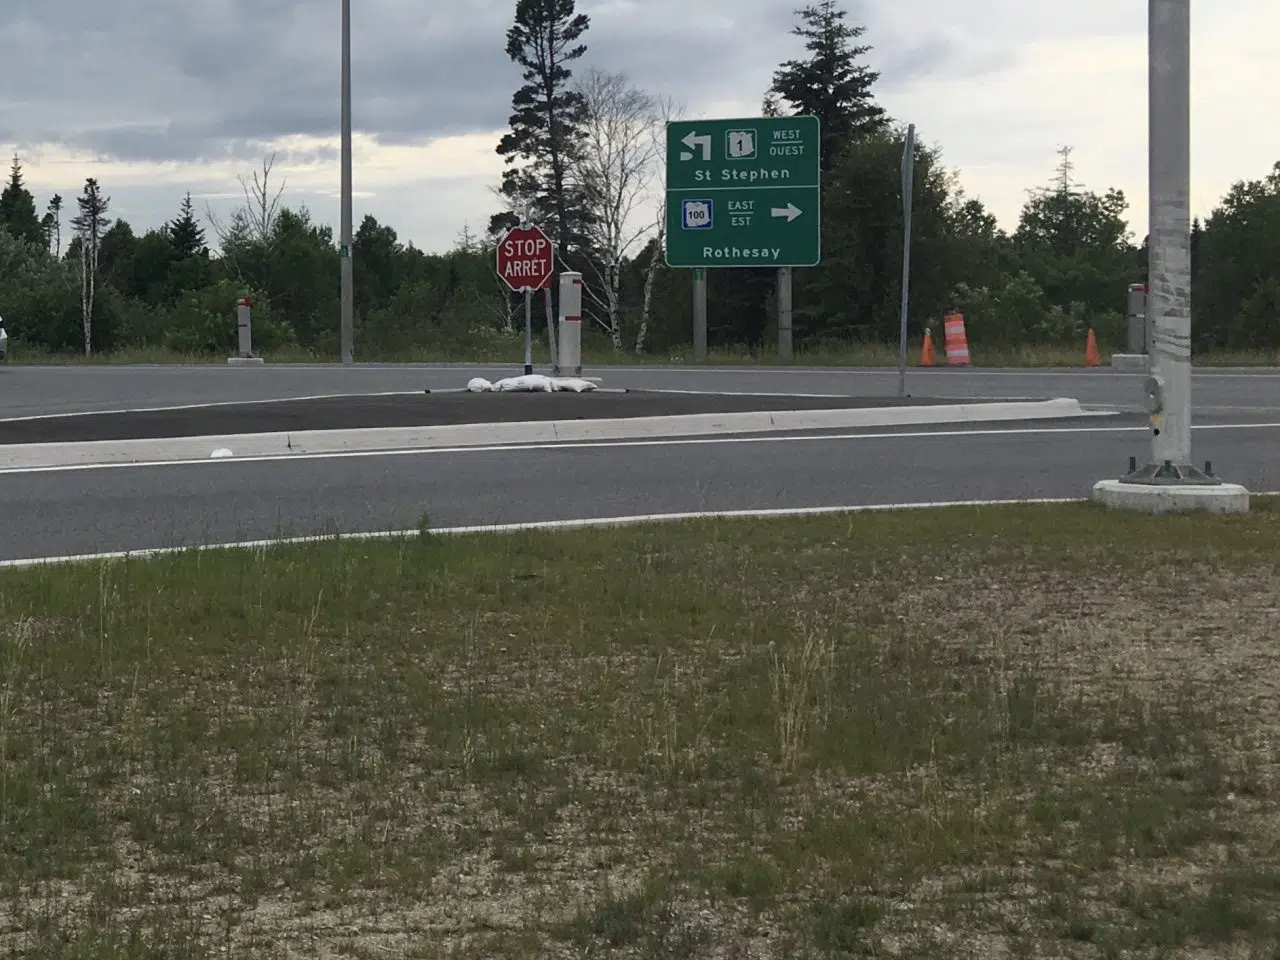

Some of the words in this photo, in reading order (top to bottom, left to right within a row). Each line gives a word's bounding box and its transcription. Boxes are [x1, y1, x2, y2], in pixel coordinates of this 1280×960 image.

[773, 130, 800, 139] WEST
[736, 139, 743, 152] 1
[769, 145, 804, 156] OUEST
[695, 170, 712, 181] St
[721, 168, 790, 182] Stephen
[728, 201, 754, 210] EAST
[688, 210, 705, 220] 100
[731, 217, 751, 226] EST
[504, 239, 546, 257] STOP
[703, 246, 780, 260] Rothesay
